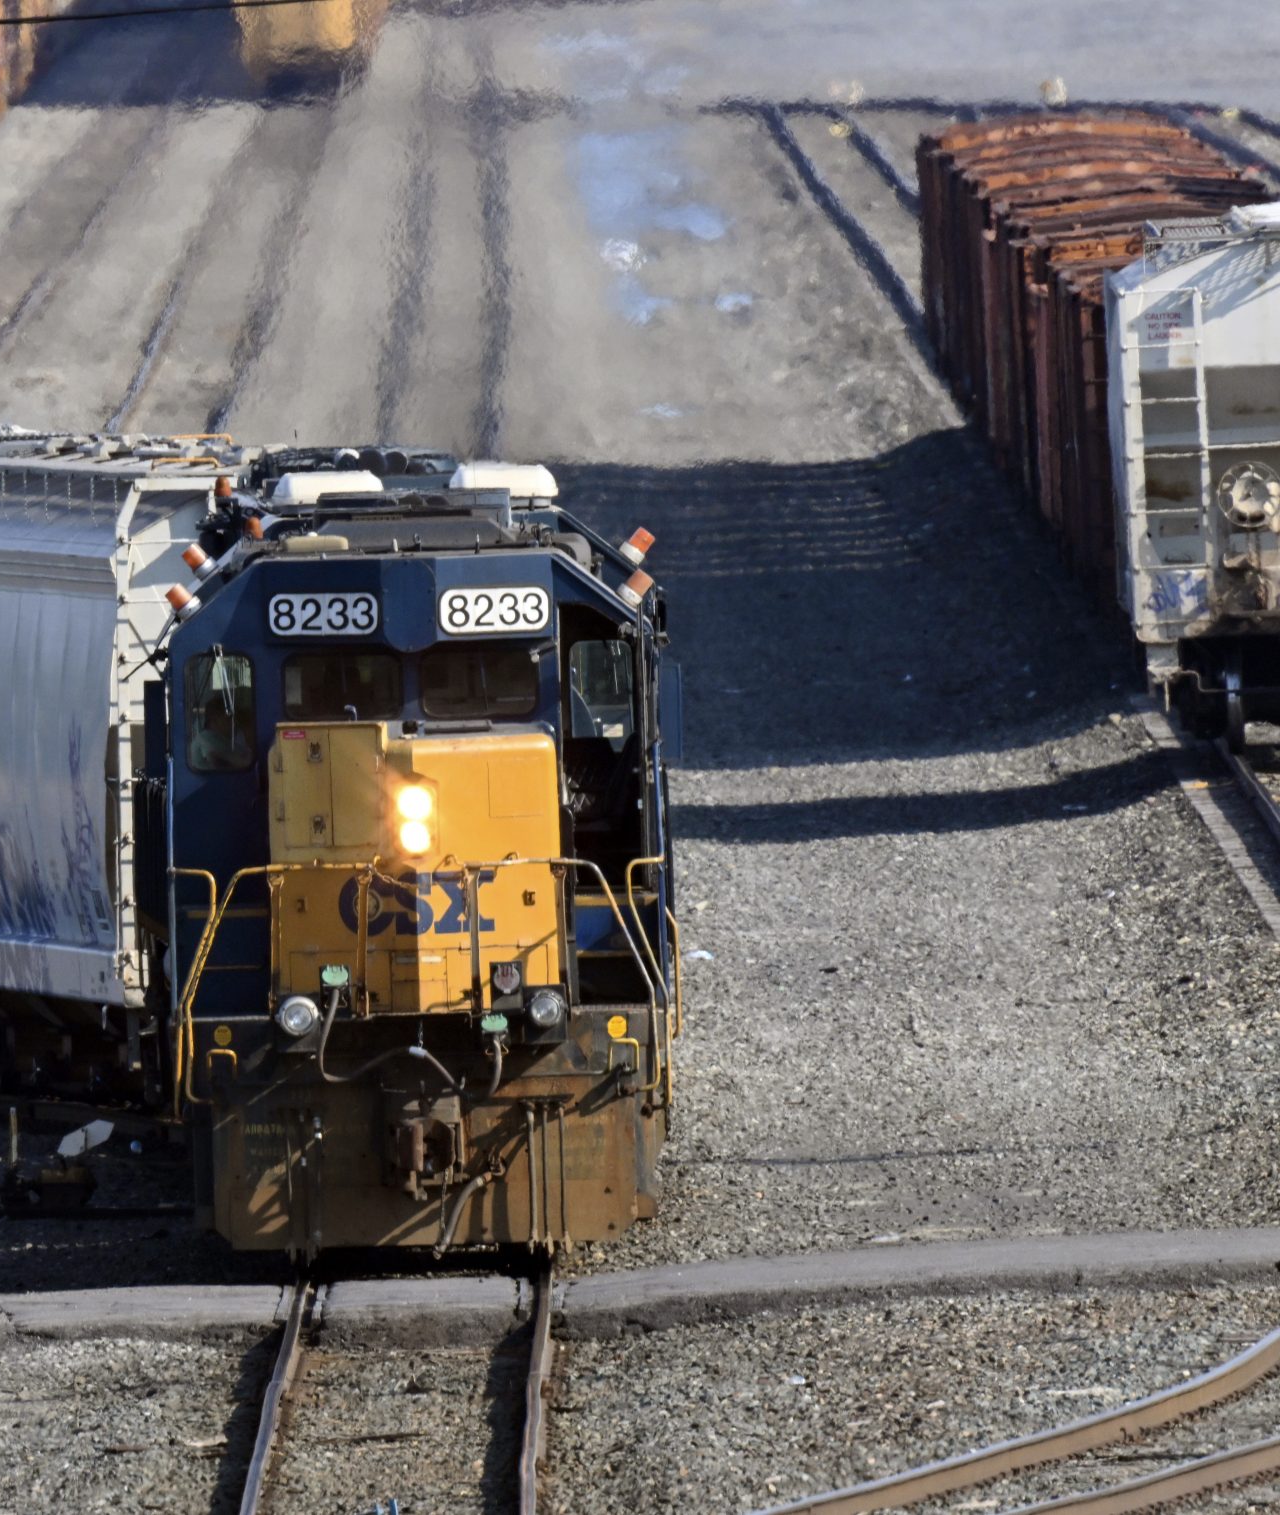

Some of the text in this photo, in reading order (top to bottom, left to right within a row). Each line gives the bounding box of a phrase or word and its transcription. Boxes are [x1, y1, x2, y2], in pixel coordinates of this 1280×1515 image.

[273, 596, 375, 631] 8233
[448, 593, 543, 628] 8233
[338, 870, 495, 936] CSX
